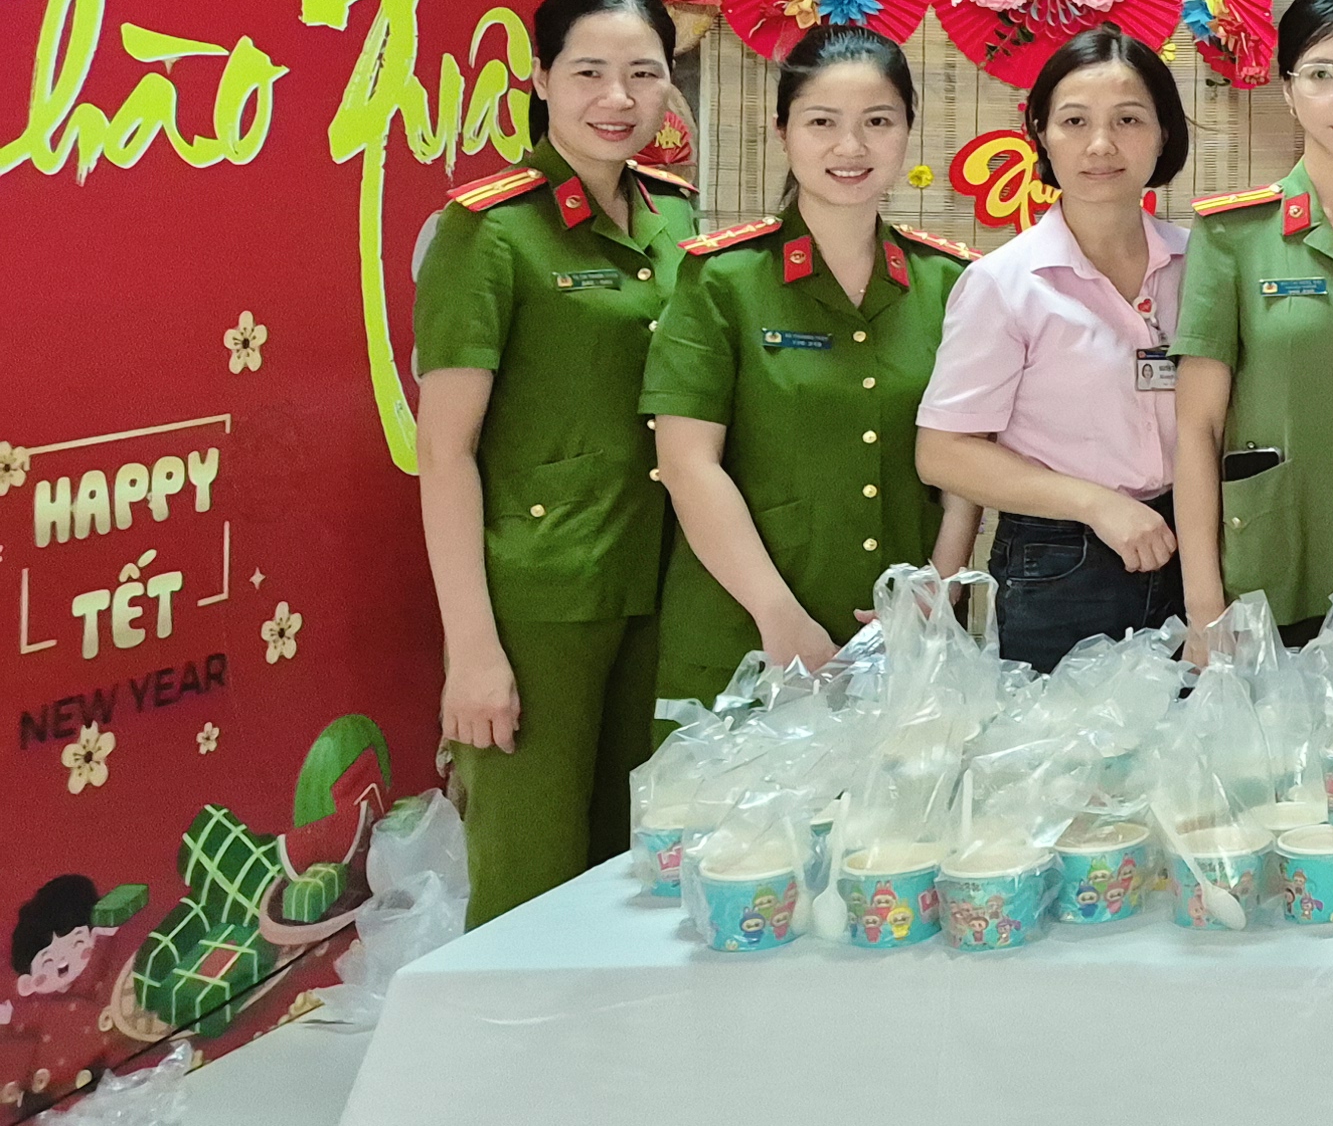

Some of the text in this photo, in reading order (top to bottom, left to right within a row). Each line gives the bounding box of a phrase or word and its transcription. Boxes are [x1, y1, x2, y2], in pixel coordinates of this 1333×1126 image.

[33, 446, 220, 549] HAPPY
[71, 548, 184, 660] TẾT
[18, 652, 230, 751] NEW YEAR
